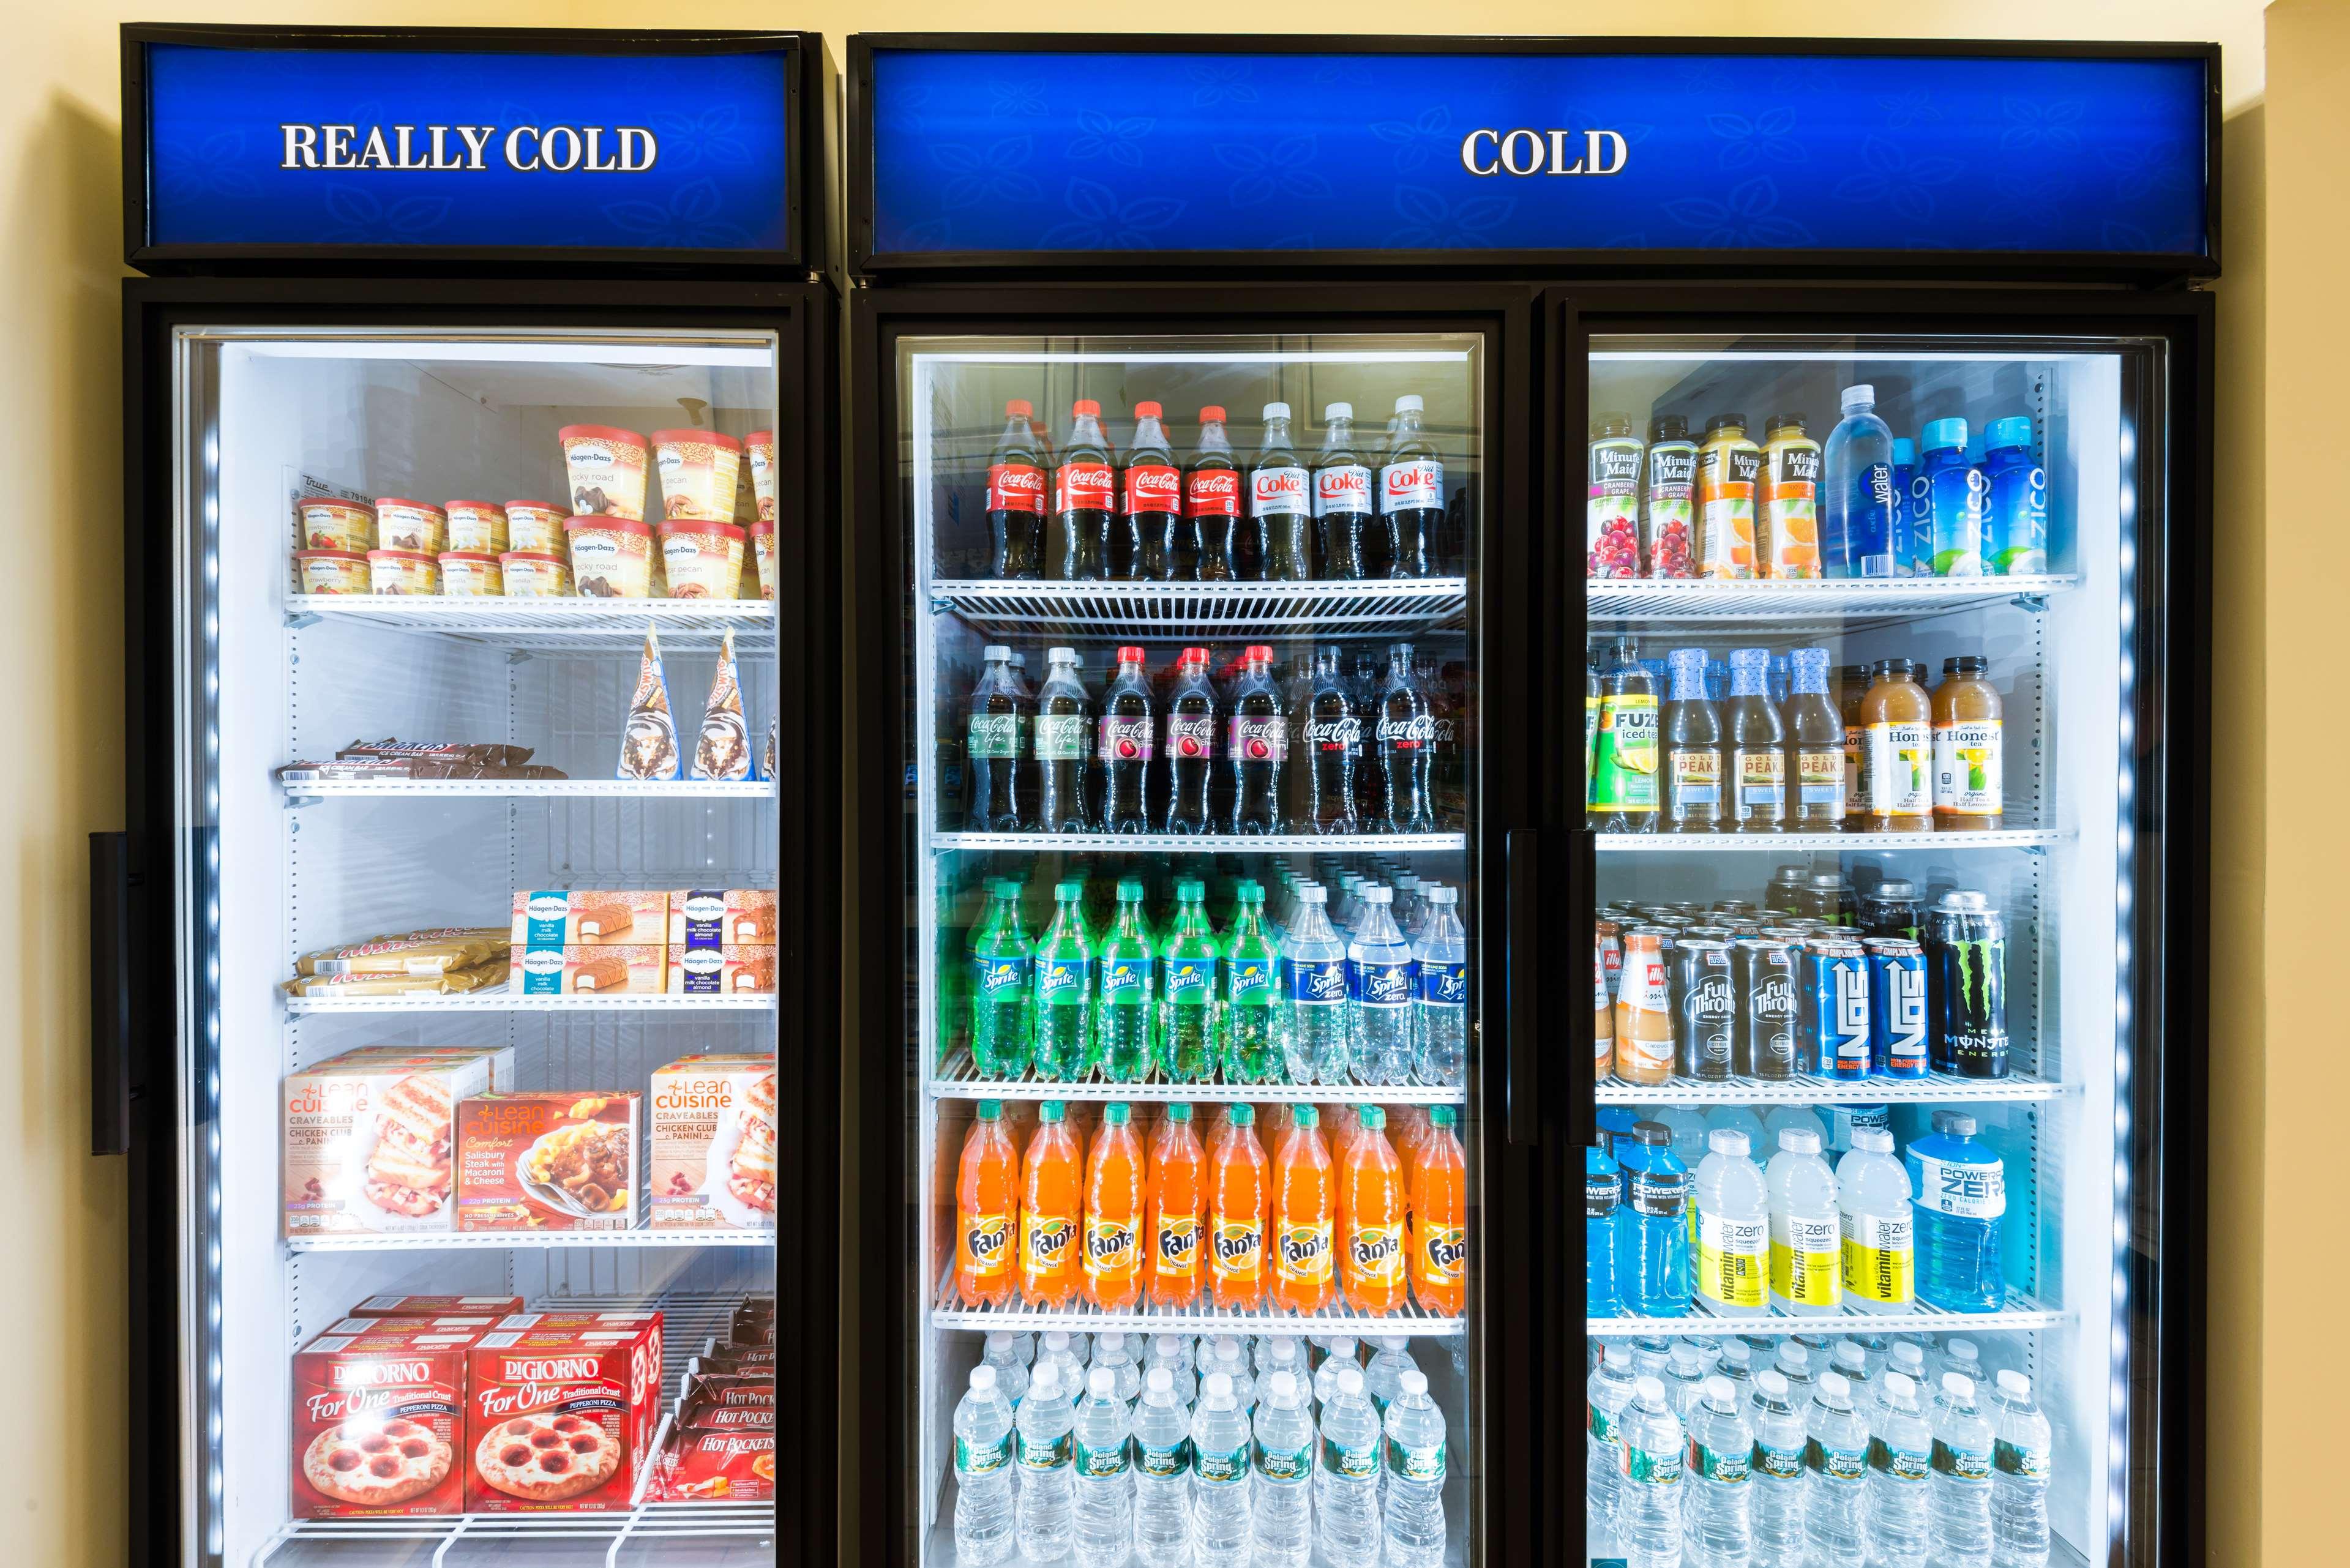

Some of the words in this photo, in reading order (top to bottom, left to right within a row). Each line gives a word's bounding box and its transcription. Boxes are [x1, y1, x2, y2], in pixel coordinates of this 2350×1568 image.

[282, 125, 495, 169] REALLY
[506, 126, 656, 171] COLD
[1463, 130, 1626, 174] COLD
[1600, 450, 1641, 464] Minute
[1658, 455, 1697, 469] Minute
[1787, 452, 1820, 466] Minute
[1284, 470, 1300, 479] Diet
[1417, 464, 1434, 472] Diet
[1606, 463, 1636, 476] Maid
[1663, 467, 1691, 479] Maid
[998, 470, 1042, 490] Coca-Cola
[1068, 469, 1112, 488] Coca-Cola
[1136, 471, 1178, 491] Coca-Cola
[1189, 474, 1234, 493] Coca-Cola
[1257, 475, 1300, 493] Coke
[1319, 472, 1364, 492] Coke
[1388, 469, 1435, 489] Coke
[1871, 465, 1891, 504] water
[2030, 468, 2046, 539] ZICO
[1912, 476, 1931, 547] ZICO
[971, 715, 1016, 733] Coca-Cola
[1039, 717, 1085, 734] Coca-Cola
[1107, 720, 1153, 737] Coca-Cola
[1170, 718, 1218, 736] Coca-Cola
[1238, 720, 1285, 738] Coca-Cola
[1303, 717, 1361, 742] Coca-Cola
[1376, 715, 1435, 741] Coca-Cola
[1623, 728, 1645, 739] iced
[1396, 740, 1421, 749] zero
[1680, 761, 1713, 772] PEAK
[1745, 762, 1778, 773] PEAK
[1802, 761, 1836, 772] PEAK
[529, 905, 568, 913] Häagen-Dazs
[686, 905, 724, 913] Häagen-Dazs
[525, 958, 563, 967] Häagen-Dazs
[684, 957, 723, 966] Häagen-Dazs
[1606, 952, 1620, 968] illy
[984, 971, 1019, 990] Sprite
[1041, 973, 1074, 991] Sprite
[1105, 972, 1137, 991] Sprite
[1168, 972, 1202, 991] Sprite
[1232, 972, 1266, 991] Sprite
[1312, 971, 1342, 993] Sprite
[1372, 976, 1404, 996] Sprite
[1945, 1034, 2008, 1050] MONSTE
[684, 1080, 732, 1094] Lean
[290, 1116, 353, 1125] CRAVEABLES
[495, 1106, 544, 1121] Lean
[466, 1137, 514, 1151] Comfort
[465, 1151, 505, 1160] Salisbury
[1940, 1167, 2003, 1181] POWERA
[1735, 1226, 1764, 1237] zero
[1805, 1224, 1835, 1235] zero
[967, 1223, 1016, 1258] Fanta
[1030, 1223, 1077, 1258] Fanta
[1087, 1230, 1134, 1260] Fanta
[1159, 1225, 1205, 1258] Fanta
[1214, 1230, 1262, 1260] Fanta
[1279, 1234, 1329, 1264] Fanta
[1349, 1236, 1398, 1265] Fanta
[1721, 1222, 1734, 1299] vitaminwater
[1792, 1219, 1805, 1298] vitaminwater
[306, 1391, 345, 1422] For
[346, 1386, 391, 1414] One
[432, 1391, 452, 1402] Crust
[479, 1387, 516, 1417] For
[517, 1381, 560, 1409] One
[563, 1386, 601, 1399] Traditional
[601, 1386, 621, 1397] Crust
[570, 1400, 599, 1409] PEPPERONI
[726, 1392, 747, 1405] HOT
[400, 1404, 430, 1413] PEPPERONI
[715, 1411, 737, 1424] HOT
[702, 1438, 727, 1452] HOT
[1025, 1447, 1055, 1461] Spring
[1145, 1455, 1176, 1468] Spring
[1090, 1455, 1121, 1469] Spring
[1201, 1460, 1232, 1474] Spring
[1265, 1457, 1297, 1471] Spring
[1716, 1463, 1748, 1476] Spring
[1766, 1458, 1799, 1471] Spring
[1829, 1458, 1863, 1472] Spring
[1893, 1458, 1928, 1472] Spring
[1956, 1458, 1991, 1472] Spring
[1653, 1463, 1680, 1477] Spring
